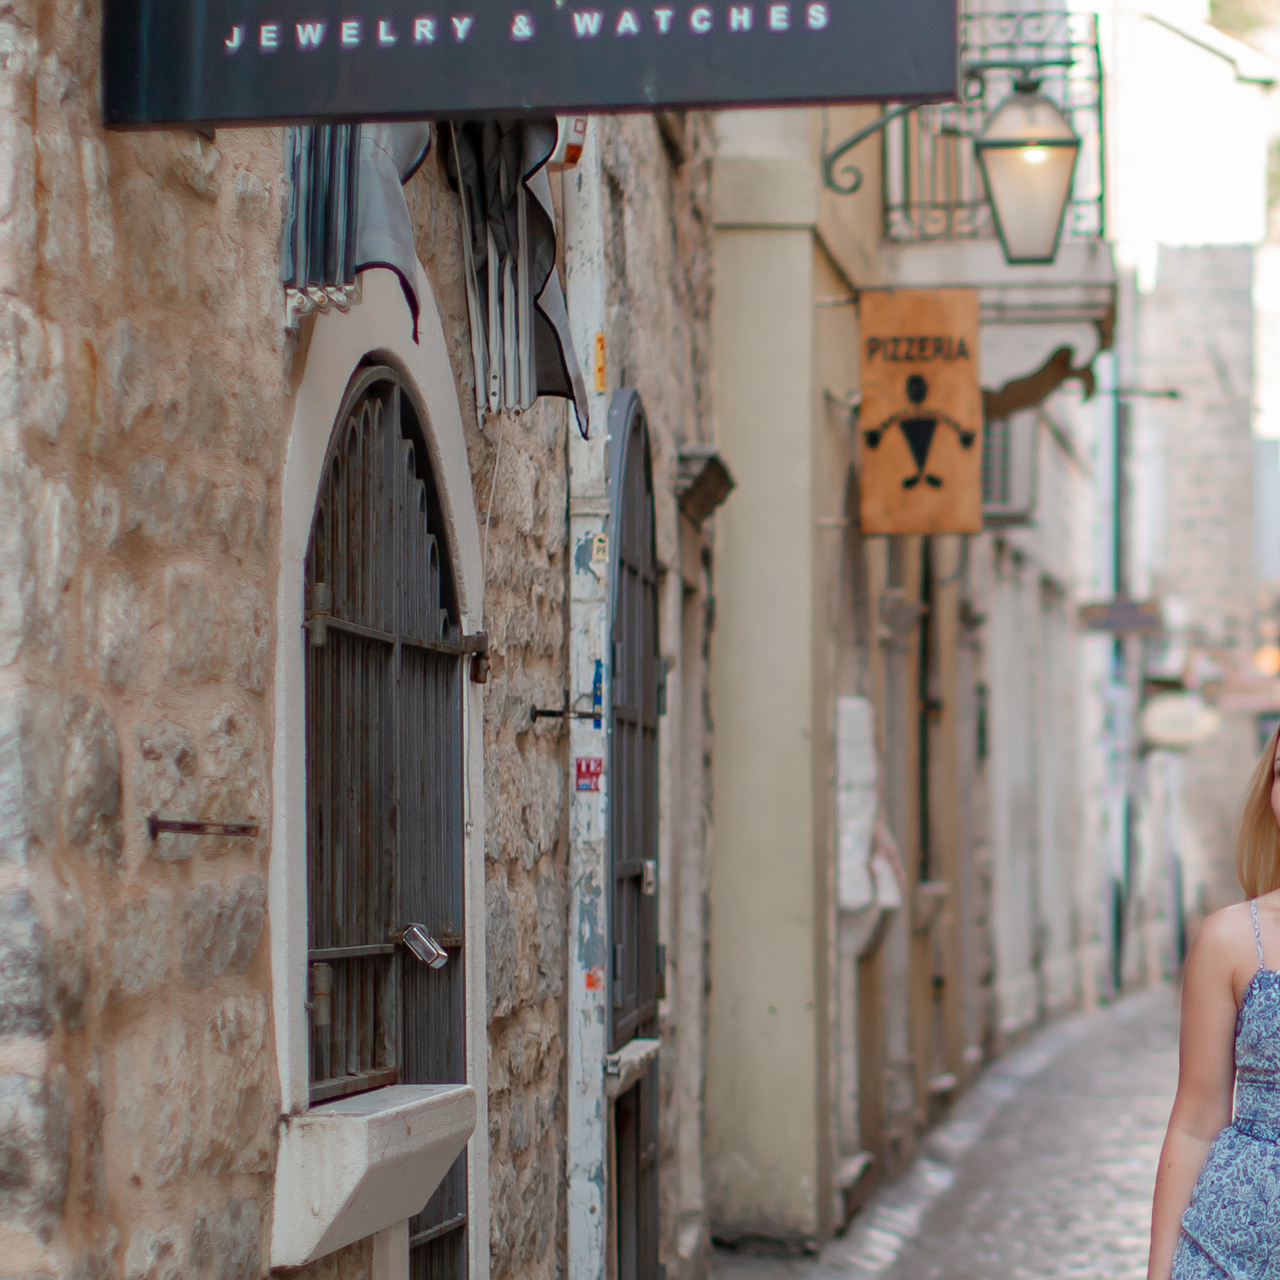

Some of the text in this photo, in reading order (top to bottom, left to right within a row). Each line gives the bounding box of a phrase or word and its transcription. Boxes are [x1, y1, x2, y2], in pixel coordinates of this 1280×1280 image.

[224, 2, 831, 49] JEWELRY & WATCHES
[866, 336, 971, 362] PIZZERIA
